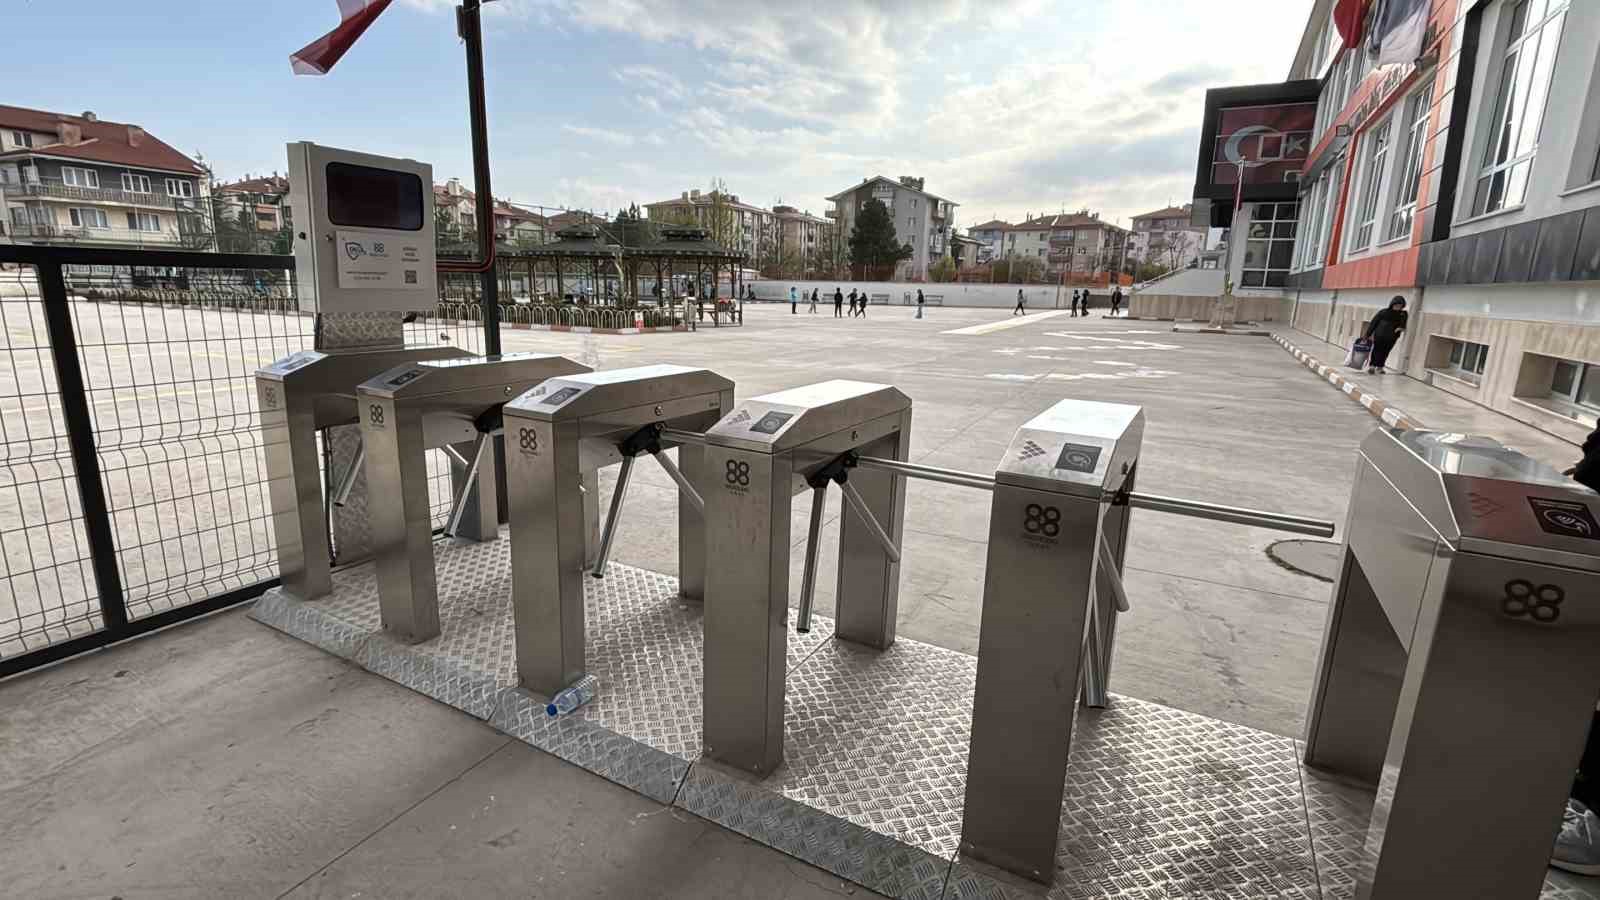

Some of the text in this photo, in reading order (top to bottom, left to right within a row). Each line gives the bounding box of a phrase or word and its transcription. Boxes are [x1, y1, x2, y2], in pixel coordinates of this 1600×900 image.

[370, 404, 384, 424] 88
[519, 427, 537, 450] 88
[726, 459, 749, 485] 88
[1024, 503, 1061, 537] 88
[1503, 578, 1565, 622] 88
